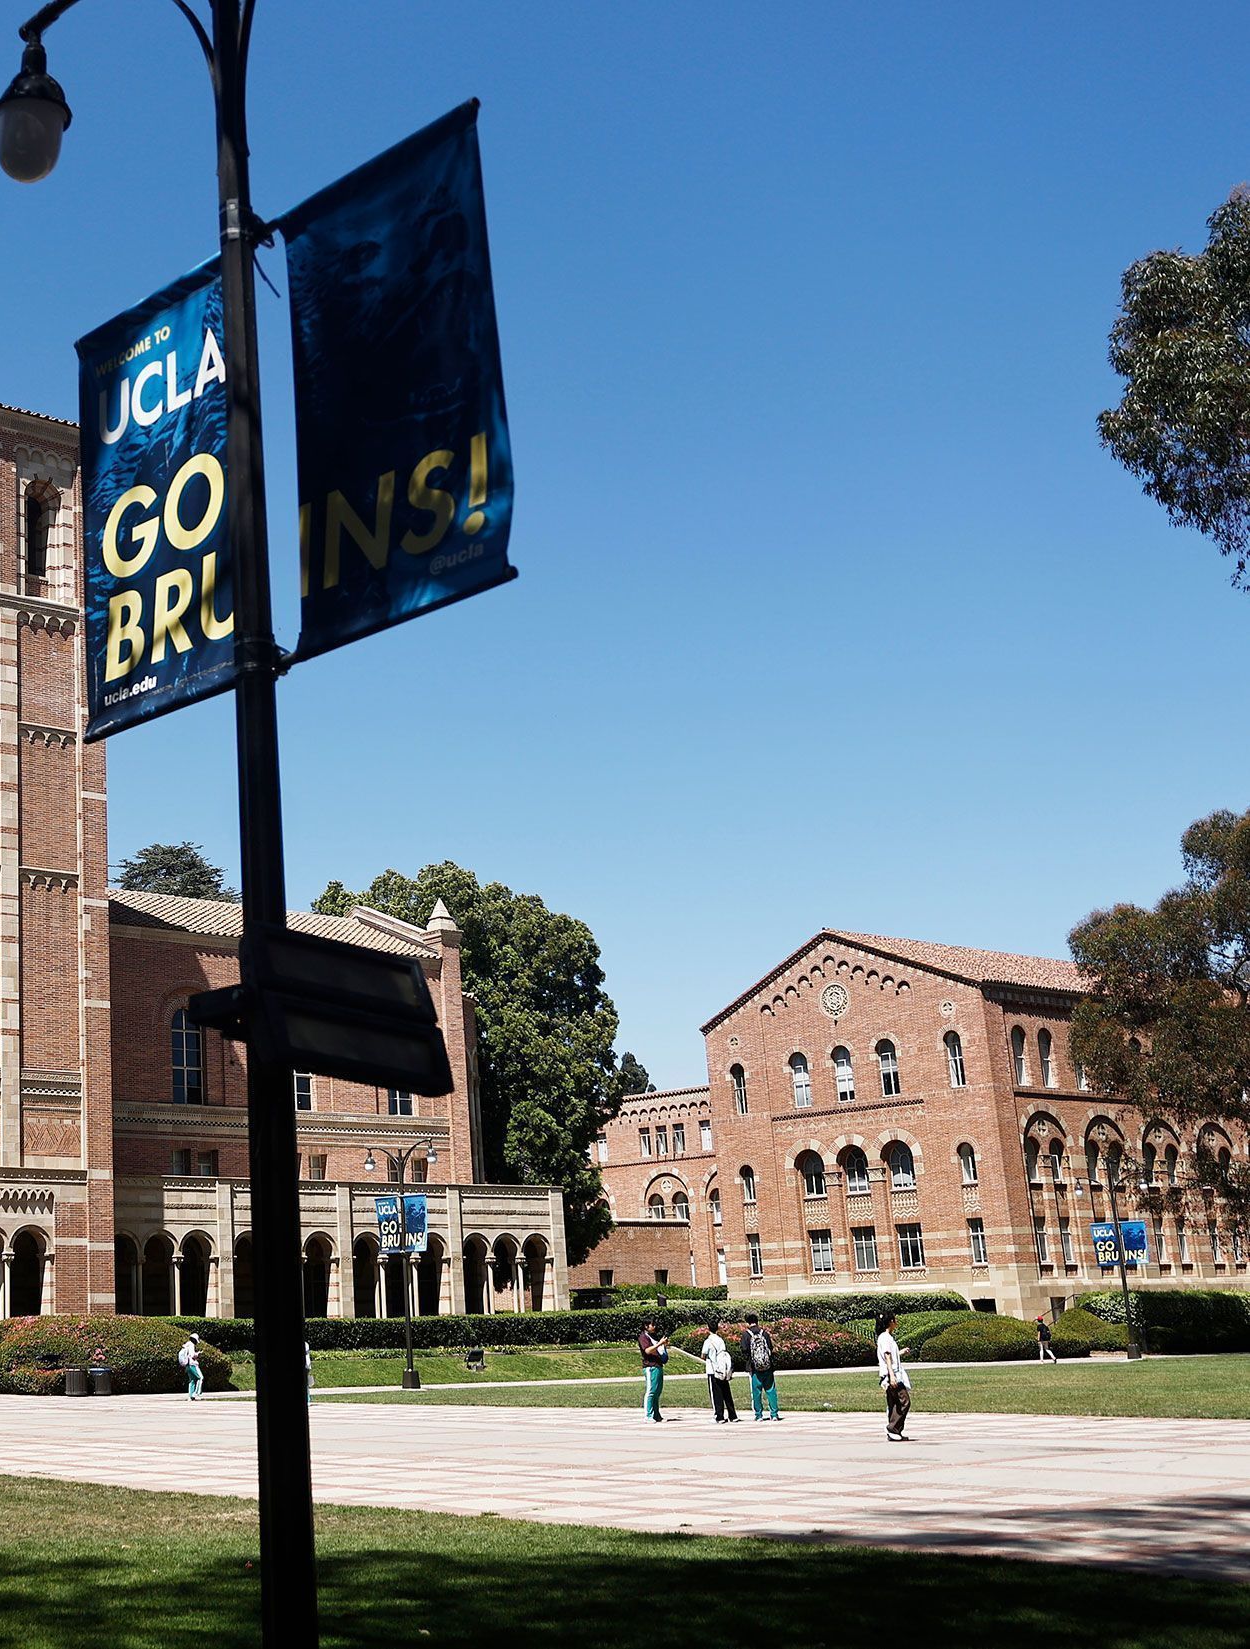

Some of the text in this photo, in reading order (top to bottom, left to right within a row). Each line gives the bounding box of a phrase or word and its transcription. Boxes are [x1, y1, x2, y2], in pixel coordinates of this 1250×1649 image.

[98, 326, 170, 377] WELCOME TO
[101, 328, 226, 445] UCLA
[103, 453, 225, 578] GO
[430, 543, 484, 575] @ucla
[105, 676, 157, 706] ucla.edu
[378, 1205, 397, 1215] UCLA
[381, 1220, 397, 1234] GO
[1093, 1229, 1114, 1237] UCLA
[382, 1234, 400, 1248] BRU
[1096, 1241, 1115, 1251] GO
[1098, 1251, 1119, 1261] BRU
